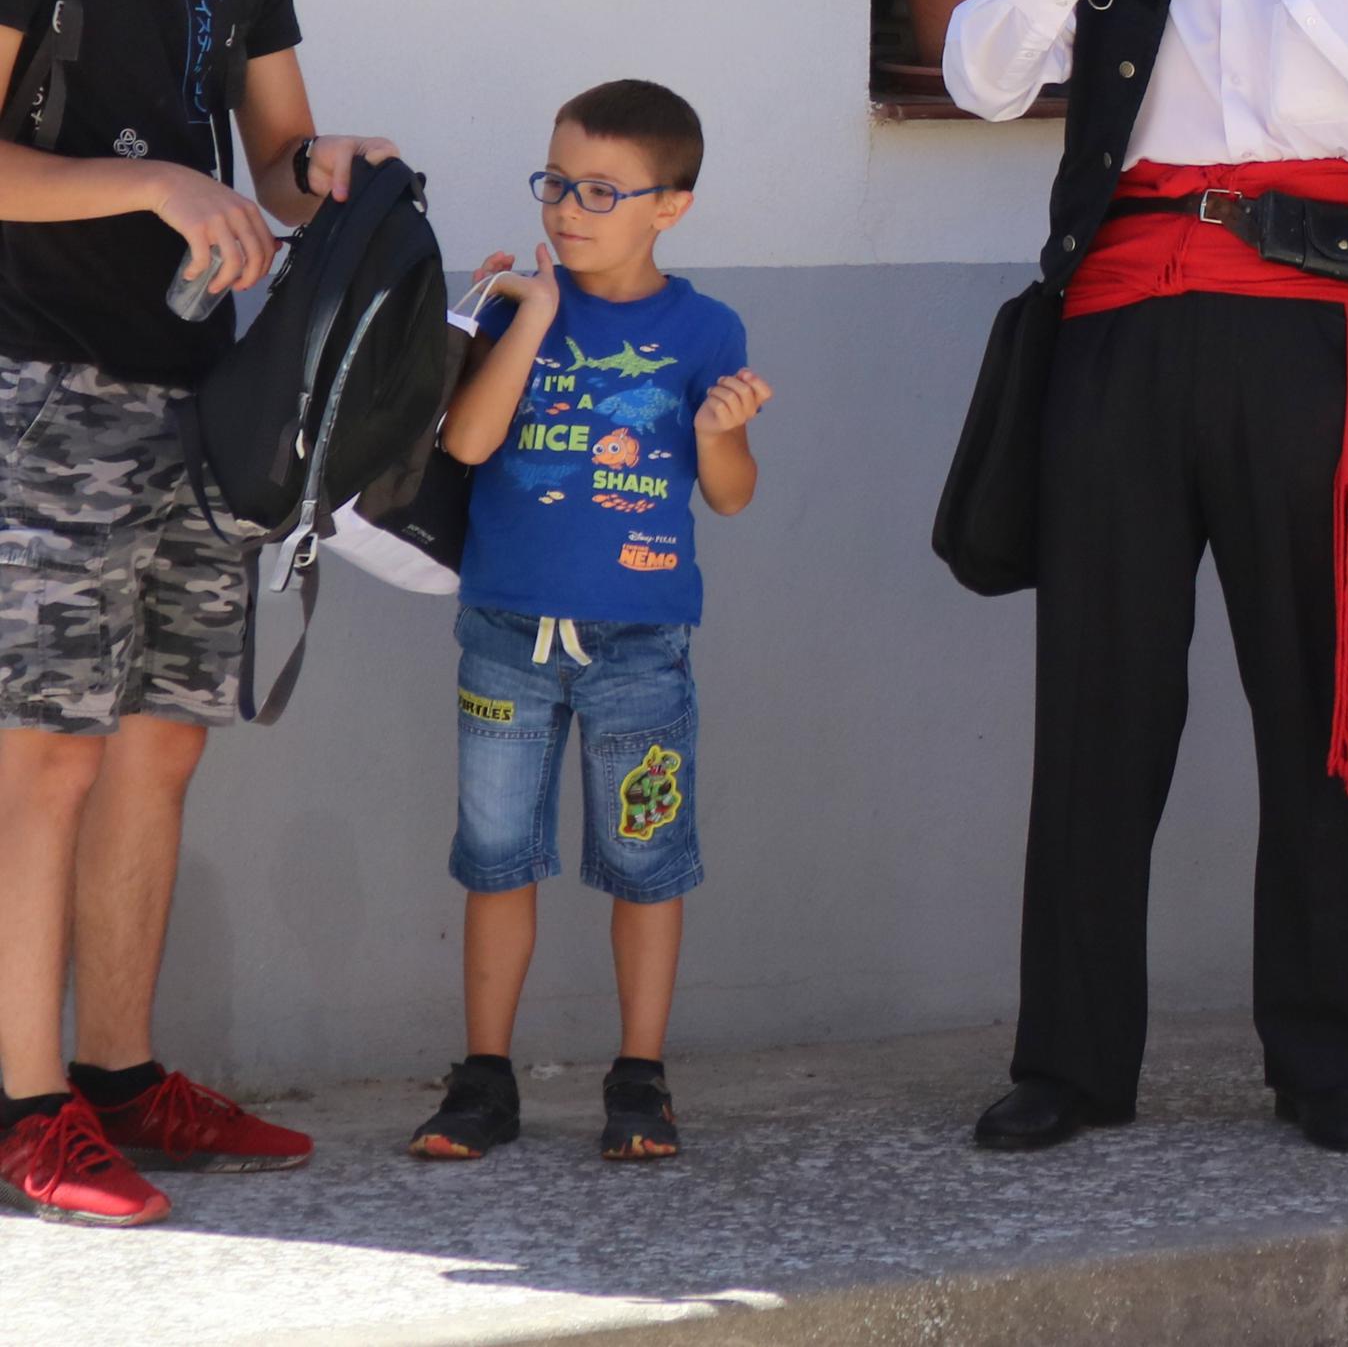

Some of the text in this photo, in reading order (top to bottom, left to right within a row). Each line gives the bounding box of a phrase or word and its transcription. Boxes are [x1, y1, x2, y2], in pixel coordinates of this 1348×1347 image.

[544, 375, 575, 392] I'M
[577, 394, 593, 410] A
[518, 424, 590, 451] NICE
[593, 470, 669, 499] SHARK
[619, 549, 678, 570] NEMO
